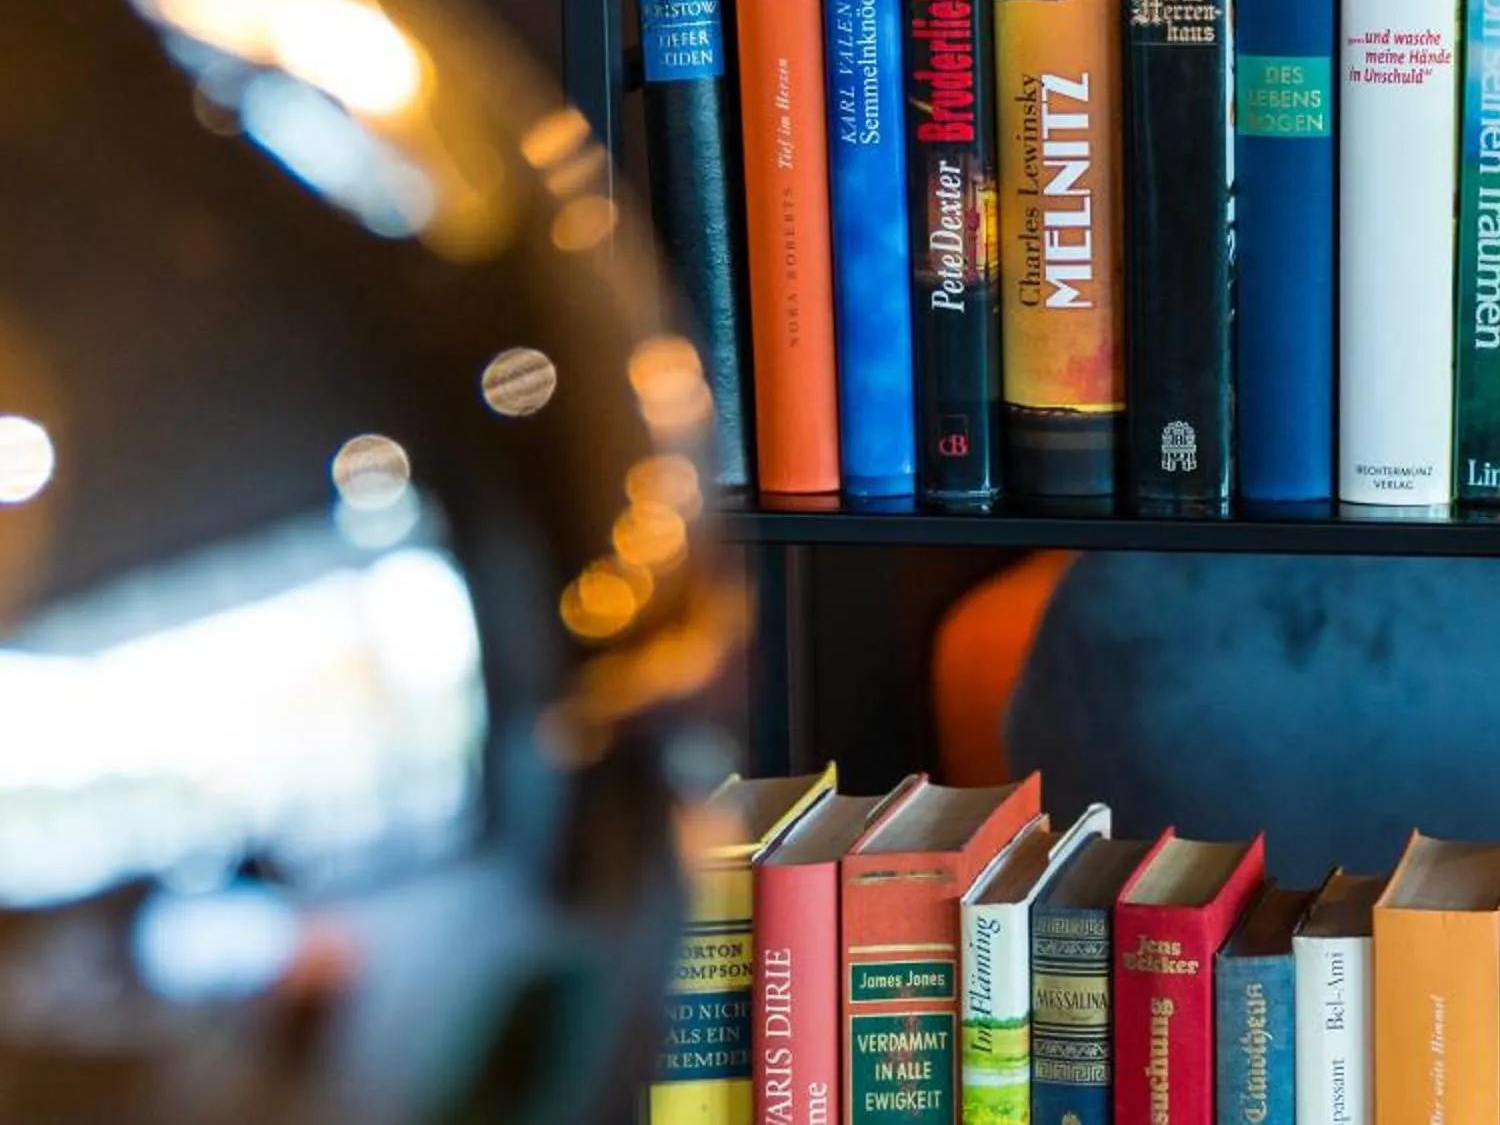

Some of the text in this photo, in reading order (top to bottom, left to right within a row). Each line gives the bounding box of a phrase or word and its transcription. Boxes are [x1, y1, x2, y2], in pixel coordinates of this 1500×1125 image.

[1166, 21, 1216, 42] haus
[1393, 29, 1441, 46] wasche
[1365, 48, 1453, 65] meine Hände
[1265, 66, 1304, 84] DES
[1349, 66, 1362, 82] in
[1249, 89, 1322, 108] LEBENS
[839, 85, 857, 145] KARL
[1014, 74, 1042, 308] Charles Lewinsky
[1042, 72, 1093, 308] MELNITZ
[1373, 478, 1415, 490] VERLAG
[679, 942, 743, 960] ORTON
[1137, 935, 1182, 956] Jens
[671, 963, 753, 980] OMPSON
[969, 915, 1001, 1016] Fläming
[860, 970, 945, 989] James Jones
[765, 948, 792, 1039] DIRIE
[1036, 989, 1109, 1011] MESSALINA
[664, 1002, 748, 1021] ND NICH
[664, 1026, 740, 1045] ALS EIN
[857, 1032, 948, 1053] VERDAMMT
[1325, 951, 1353, 1125] Bel-Ami passant
[875, 1061, 932, 1081] IN ALLE
[865, 1090, 942, 1112] EWIGKEIT
